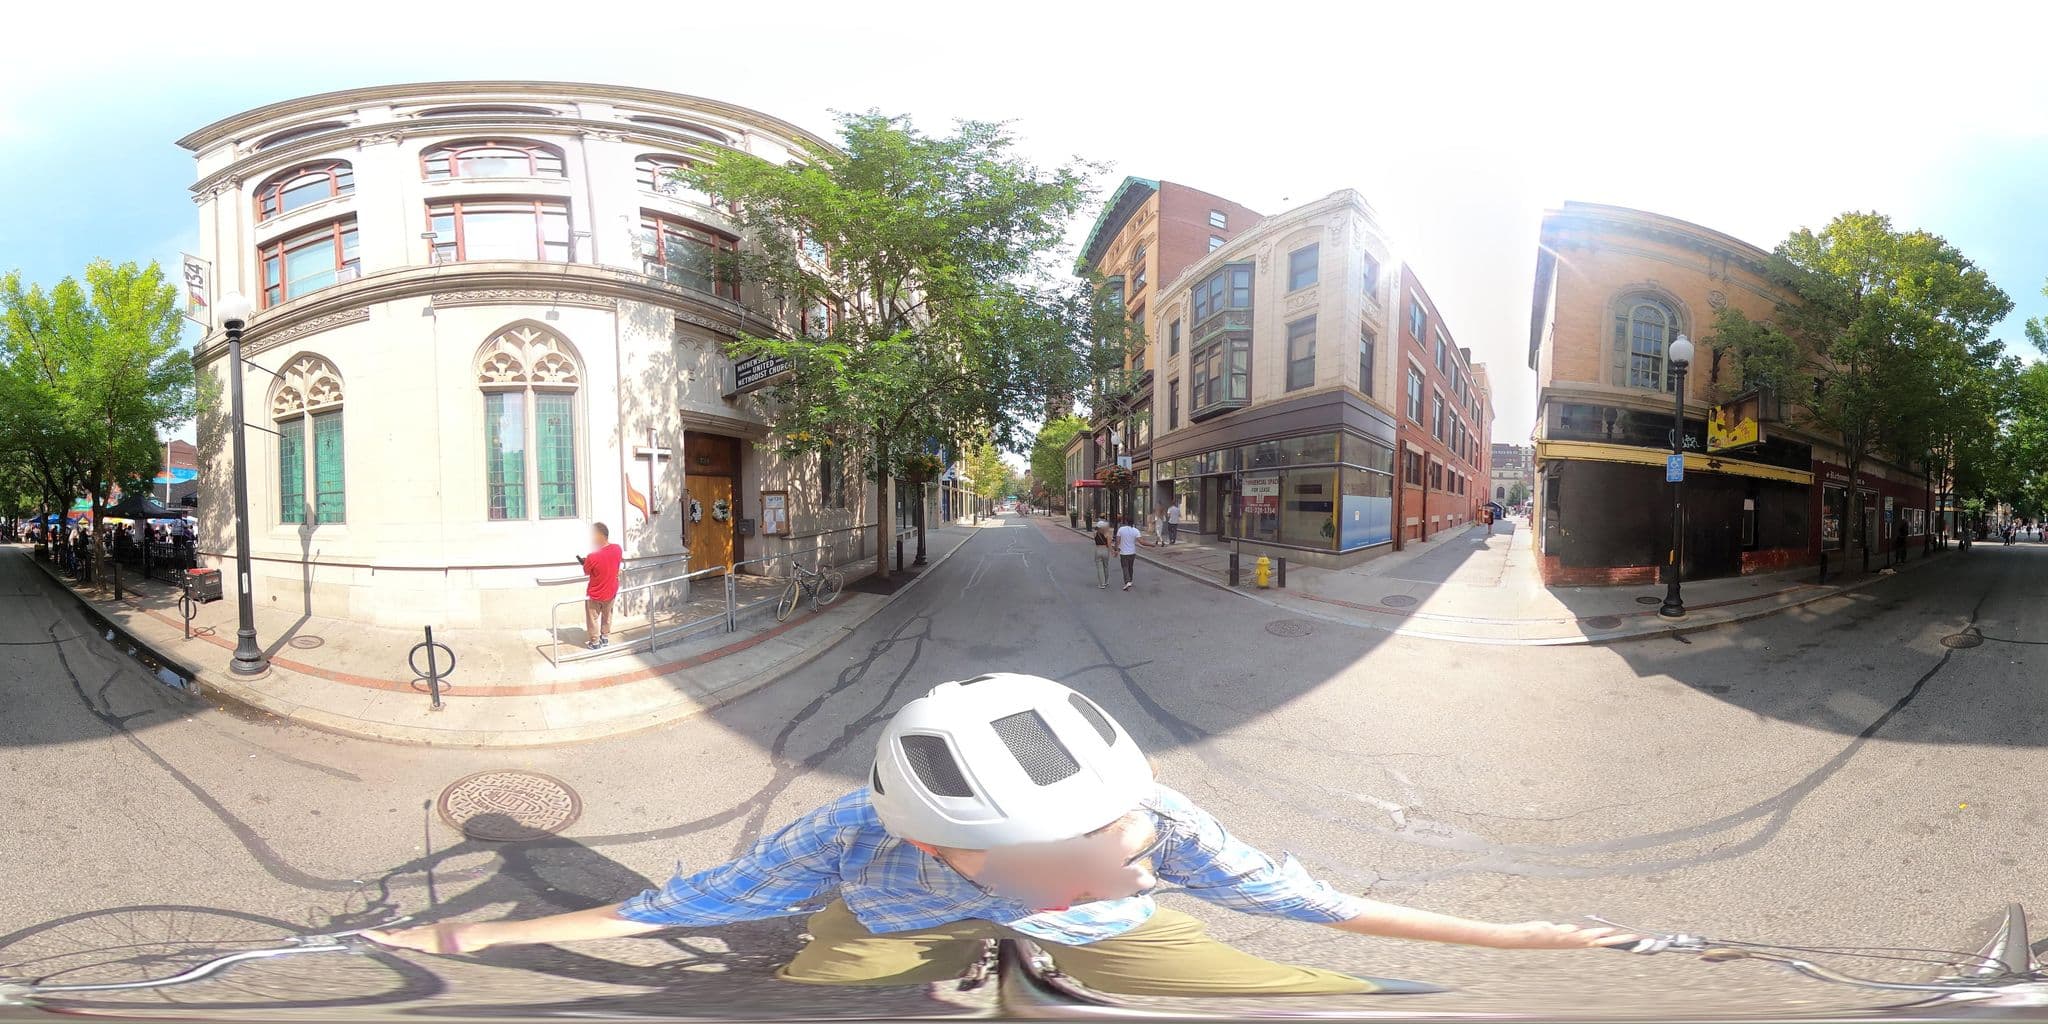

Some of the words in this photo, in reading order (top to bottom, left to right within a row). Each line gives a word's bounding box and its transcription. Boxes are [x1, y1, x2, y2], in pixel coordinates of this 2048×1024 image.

[185, 262, 204, 290] 134
[752, 360, 775, 374] UNITED
[737, 370, 768, 386] METHODIST
